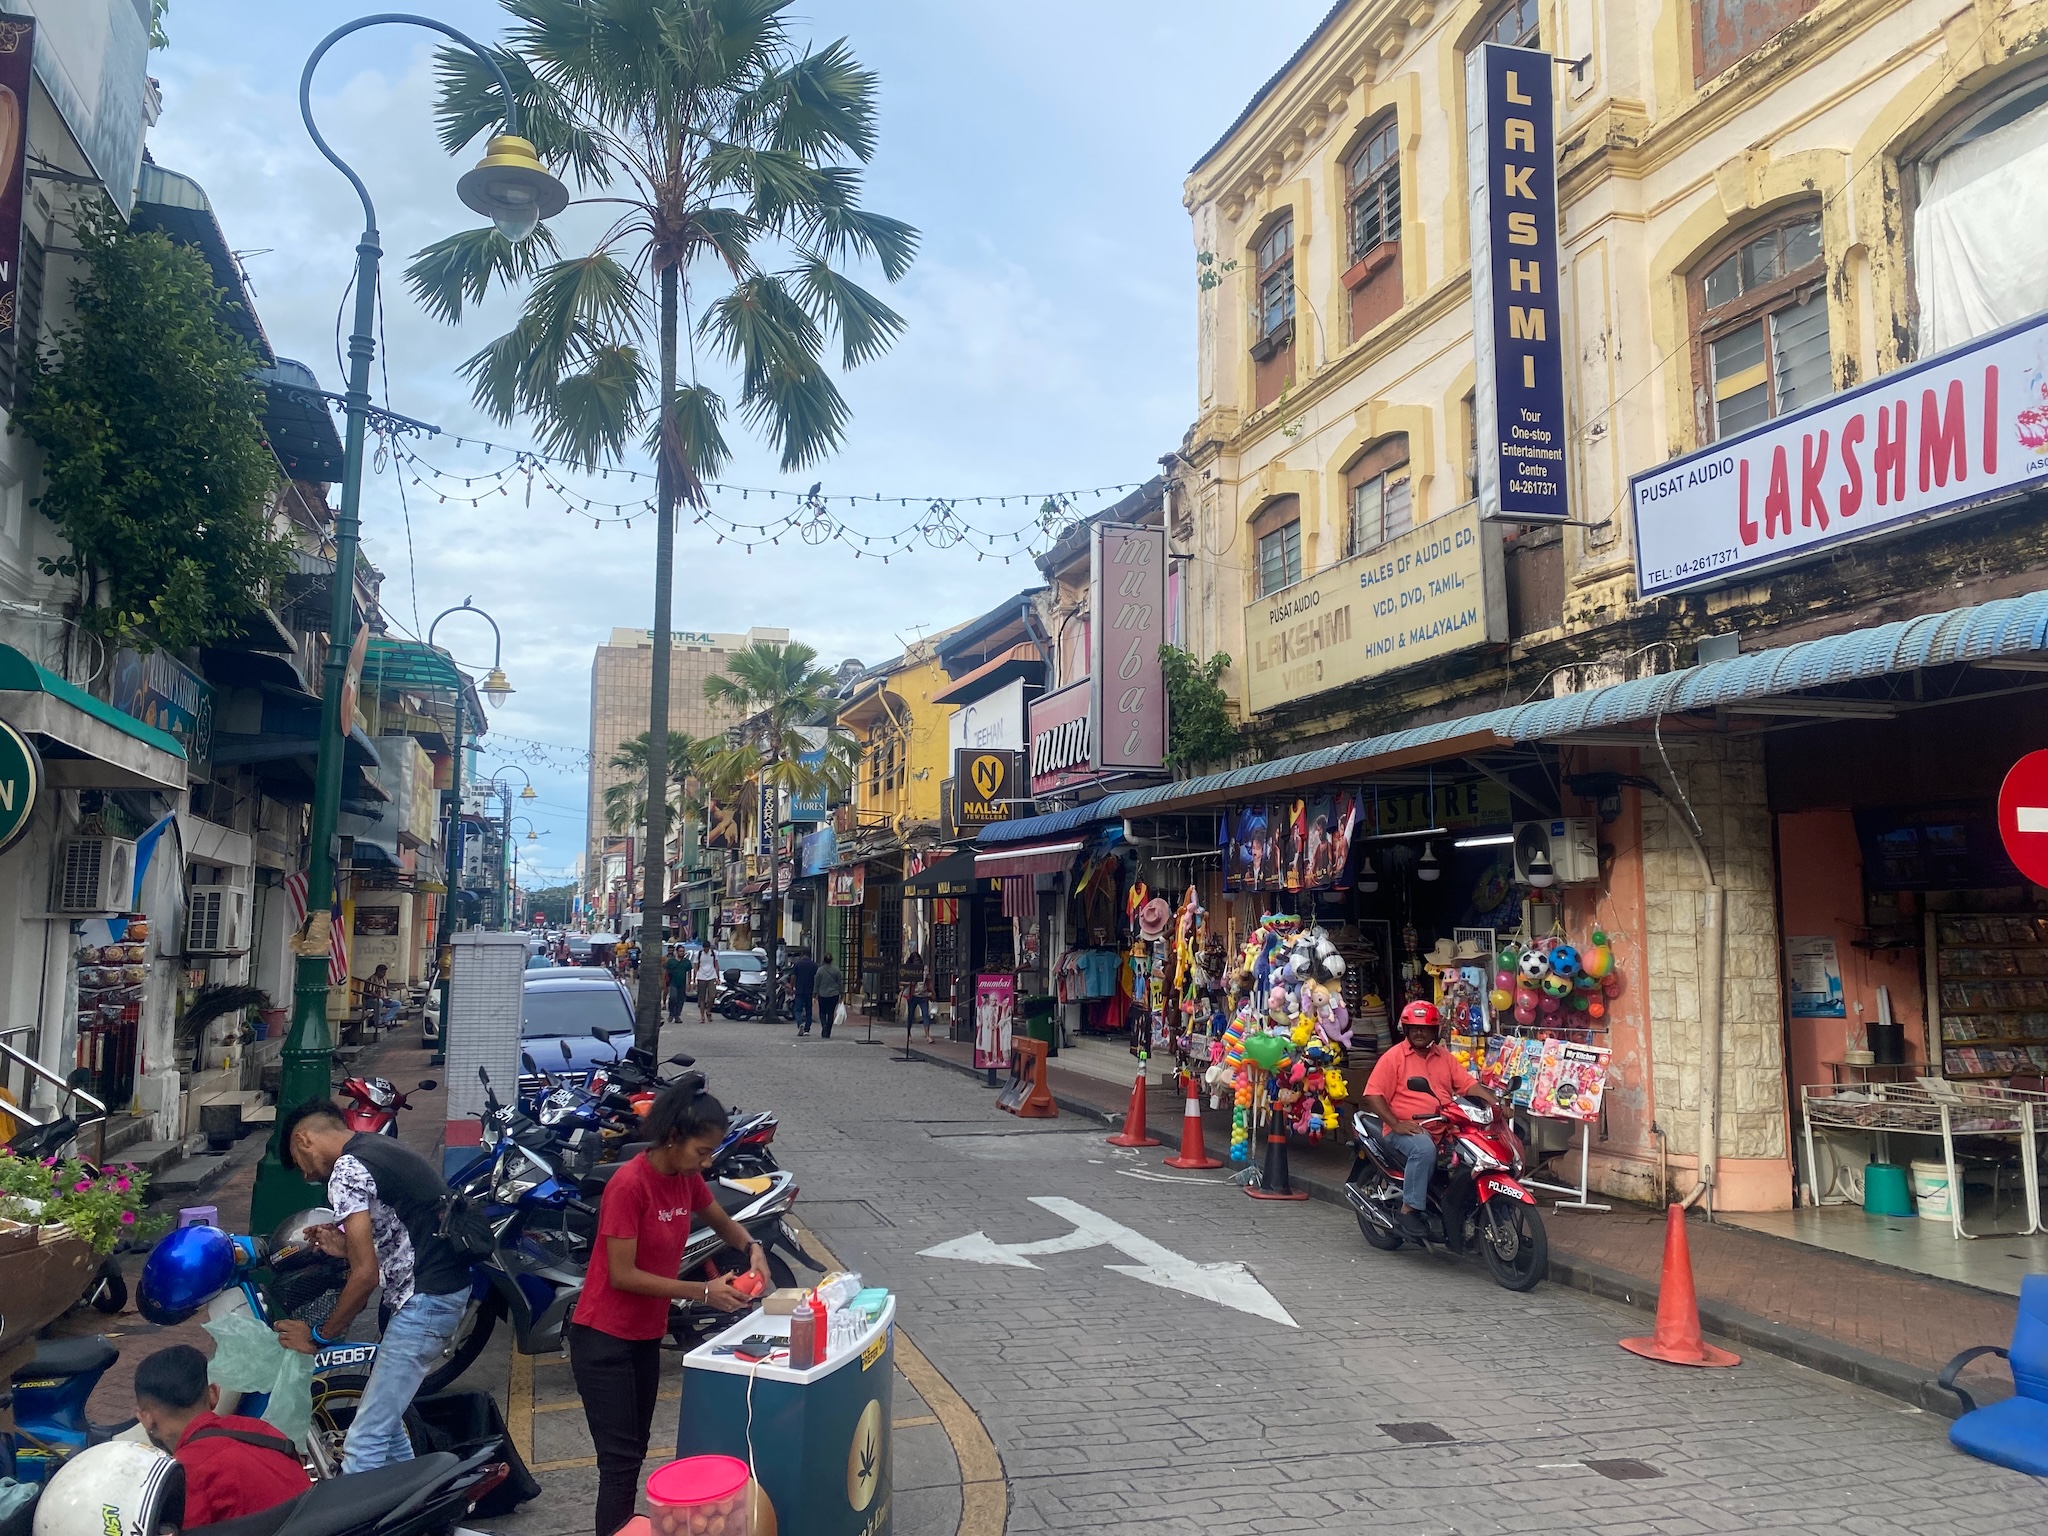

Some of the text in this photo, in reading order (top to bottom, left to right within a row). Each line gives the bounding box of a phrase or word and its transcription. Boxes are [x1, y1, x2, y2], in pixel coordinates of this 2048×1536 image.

[1504, 70, 1547, 389] LAKSHMI
[1520, 407, 1542, 423] Your
[1511, 424, 1551, 444] One-stop
[1501, 442, 1563, 461] Entertainment
[1738, 364, 1999, 548] LAKSHMI
[1518, 461, 1548, 477] Centre
[1641, 456, 1735, 505] PUSAT AUDIO
[1509, 479, 1557, 496] 04-2617371
[1360, 527, 1475, 589] SALES OF AUDIO CD,
[1648, 547, 1739, 584] TEL: 04-2617371
[1269, 590, 1320, 626] PUSAT AUDIO
[1373, 572, 1465, 618] VCD, DVD, TAMIL,
[647, 630, 715, 643] SNTRAL
[1112, 538, 1153, 757] mumbai
[1255, 604, 1352, 673] LAKSHMI
[1365, 607, 1477, 660] HINDI & MALAYALAM
[1282, 659, 1325, 691] VIDEO
[974, 717, 1004, 747] EEHAN
[793, 801, 824, 811] STORES
[1387, 783, 1480, 825] STORE
[978, 977, 1012, 988] mumbai
[1565, 1048, 1597, 1063] My Kitchen
